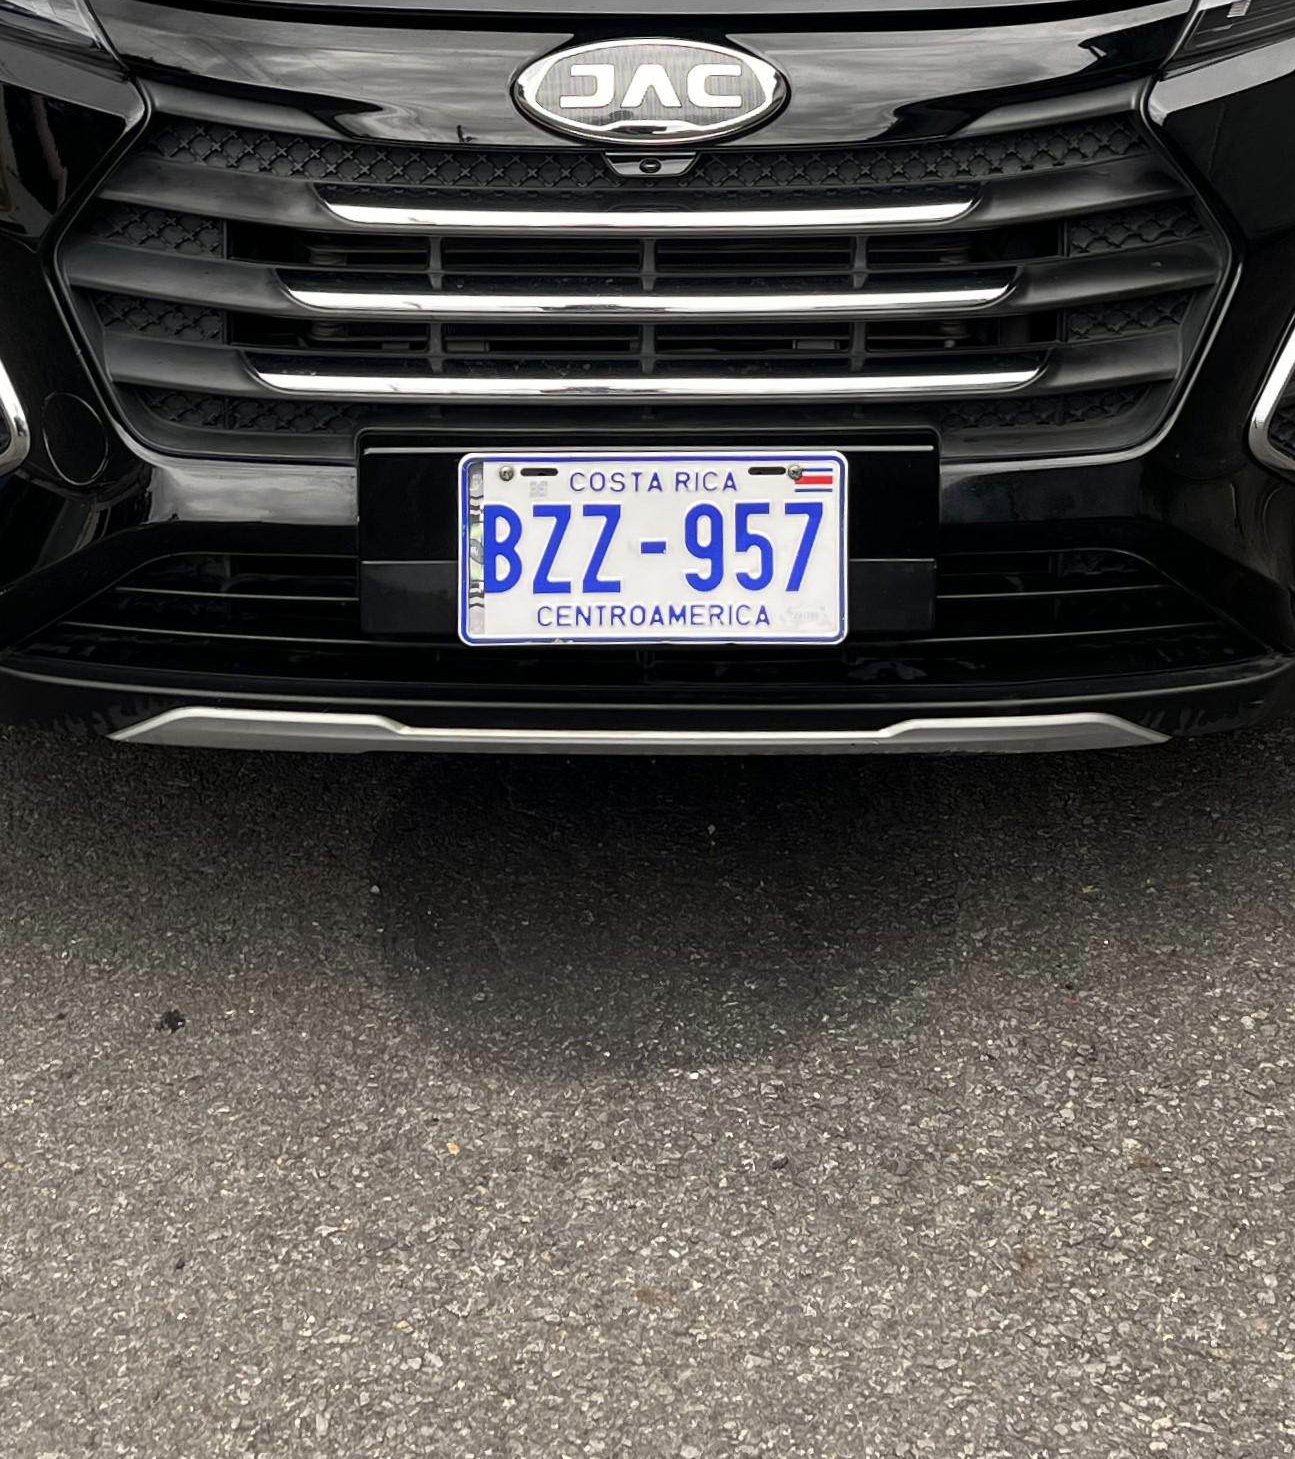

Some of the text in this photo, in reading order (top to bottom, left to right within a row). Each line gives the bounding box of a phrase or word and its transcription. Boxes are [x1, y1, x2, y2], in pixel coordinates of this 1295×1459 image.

[559, 63, 742, 108] JAC
[569, 471, 738, 493] COSTA RICA
[483, 502, 824, 595] BZZ-957
[536, 604, 771, 627] CENTROAMERICA
